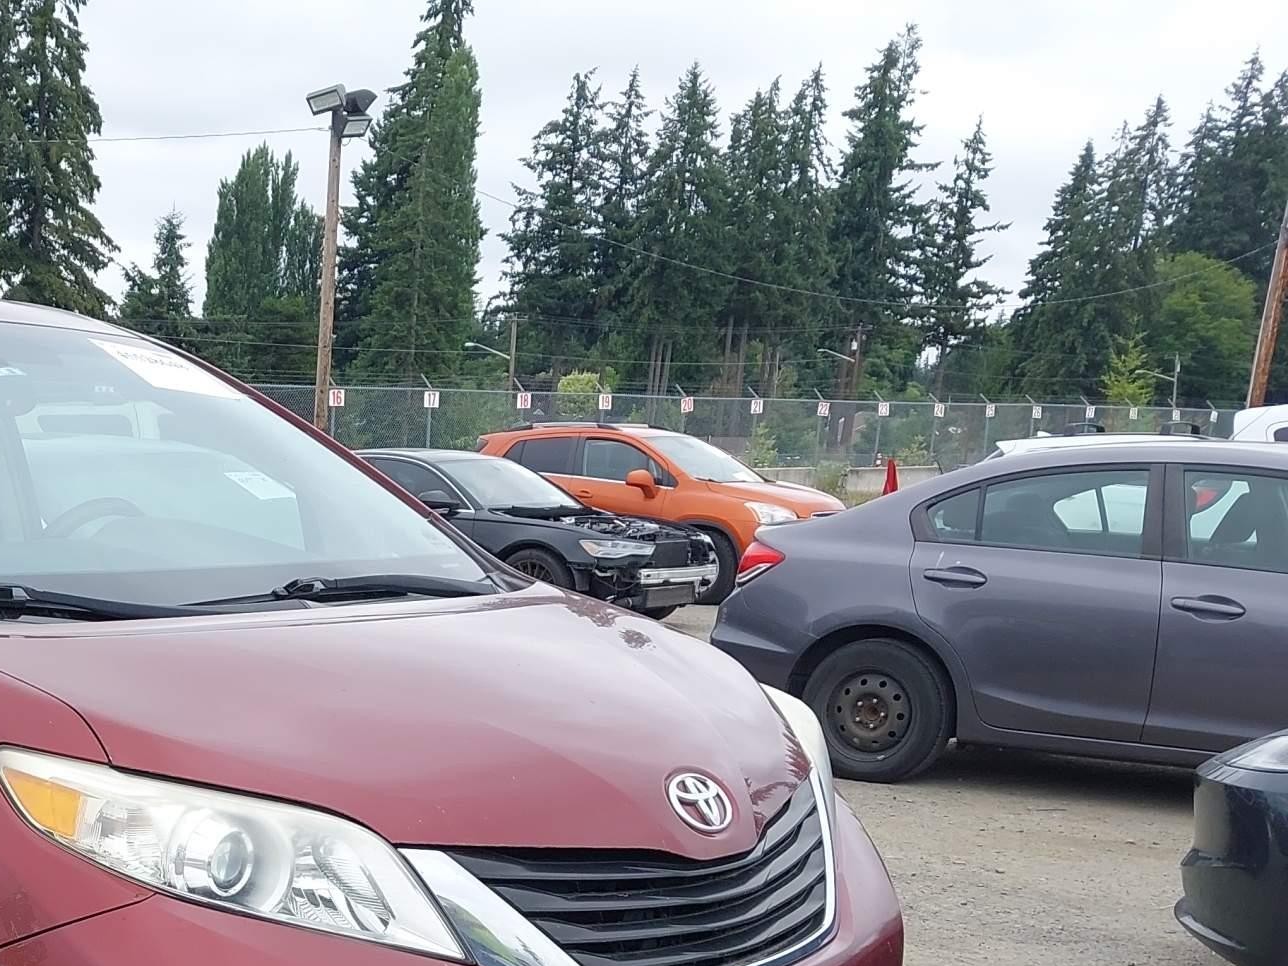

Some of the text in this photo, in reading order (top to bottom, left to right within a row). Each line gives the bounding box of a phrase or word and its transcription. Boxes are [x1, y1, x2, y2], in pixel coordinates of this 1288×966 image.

[331, 391, 342, 405] 16
[427, 393, 437, 406] 17
[520, 394, 529, 407] 18
[601, 395, 610, 408] 19
[681, 399, 692, 411] 20
[753, 401, 762, 413] 21
[818, 403, 828, 415] 22
[879, 403, 888, 415] 23
[935, 404, 943, 416] 24
